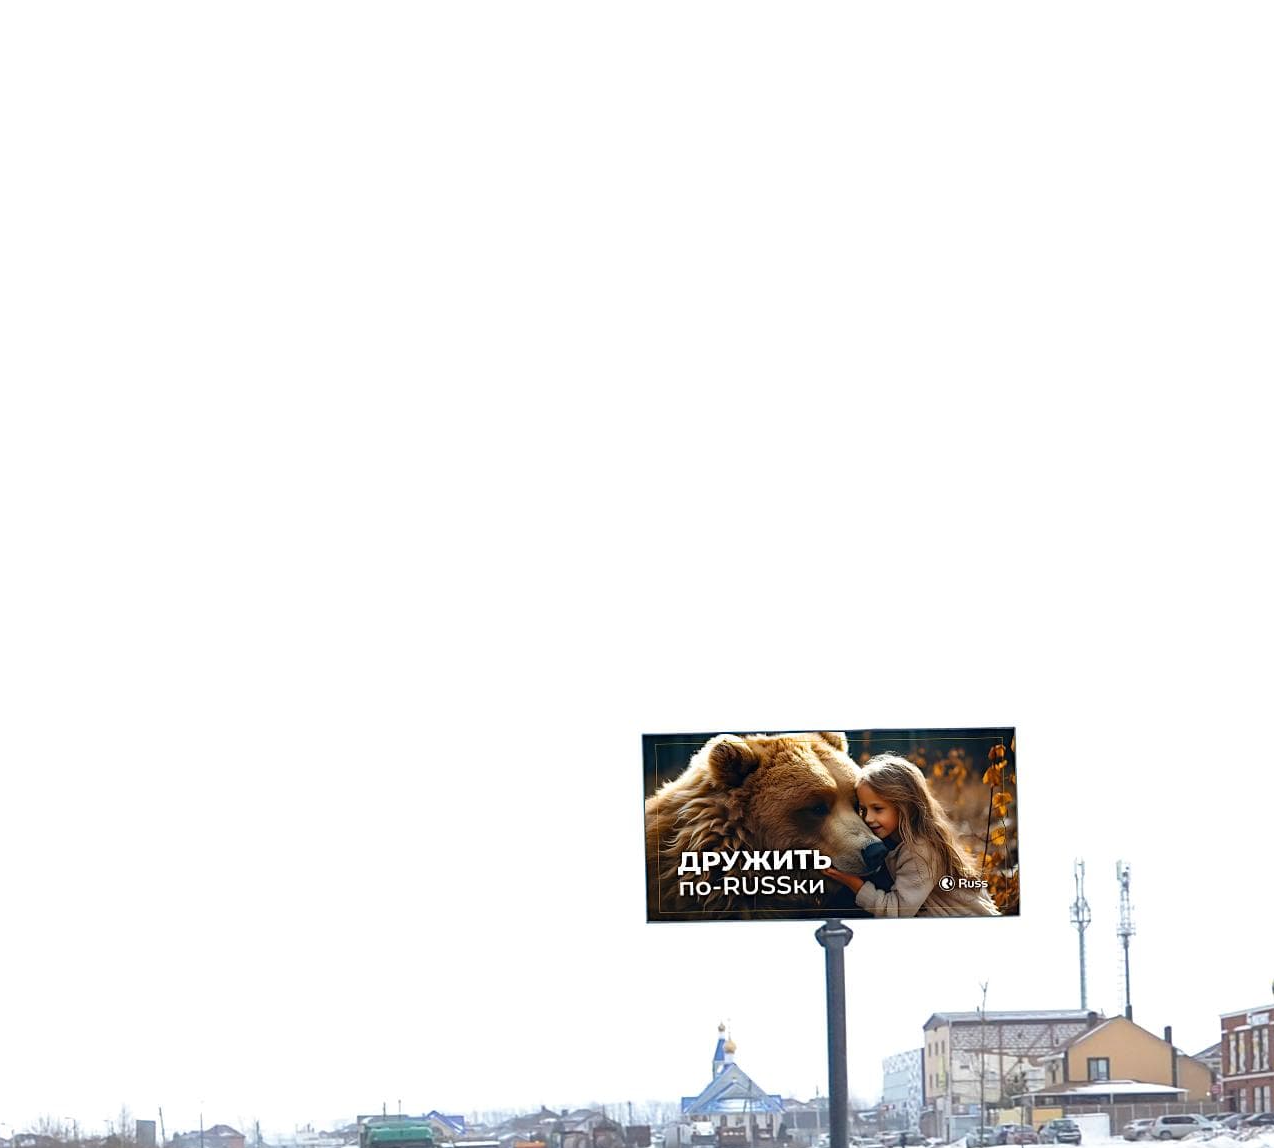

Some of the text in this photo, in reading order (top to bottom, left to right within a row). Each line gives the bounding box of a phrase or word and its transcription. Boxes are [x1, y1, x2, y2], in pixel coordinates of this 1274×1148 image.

[677, 849, 832, 876] ДРУЖИТЬ
[679, 876, 824, 897] по-RUSSки
[958, 877, 989, 889] Russ
